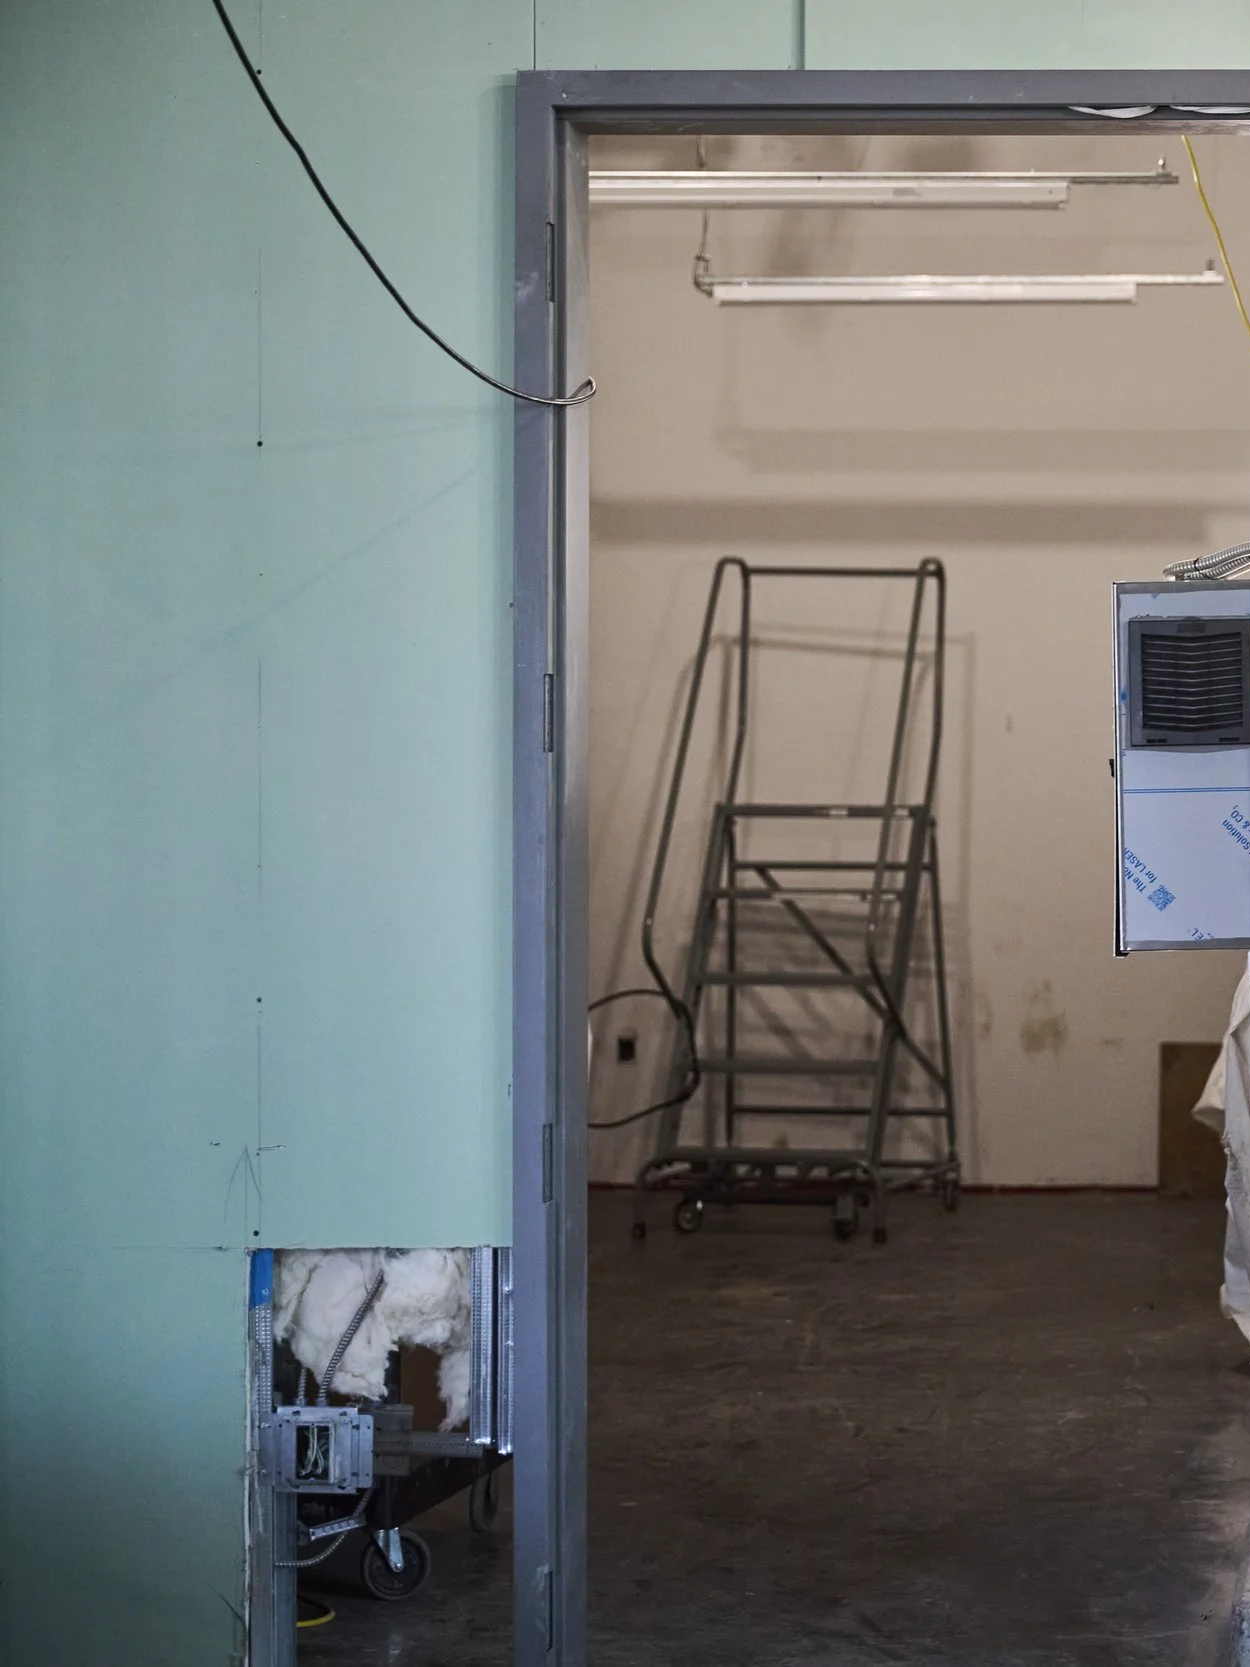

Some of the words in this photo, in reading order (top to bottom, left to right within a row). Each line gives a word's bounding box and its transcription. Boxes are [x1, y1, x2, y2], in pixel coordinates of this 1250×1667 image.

[1242, 820, 1250, 829] &
[1145, 870, 1157, 884] for
[1133, 877, 1147, 893] The
